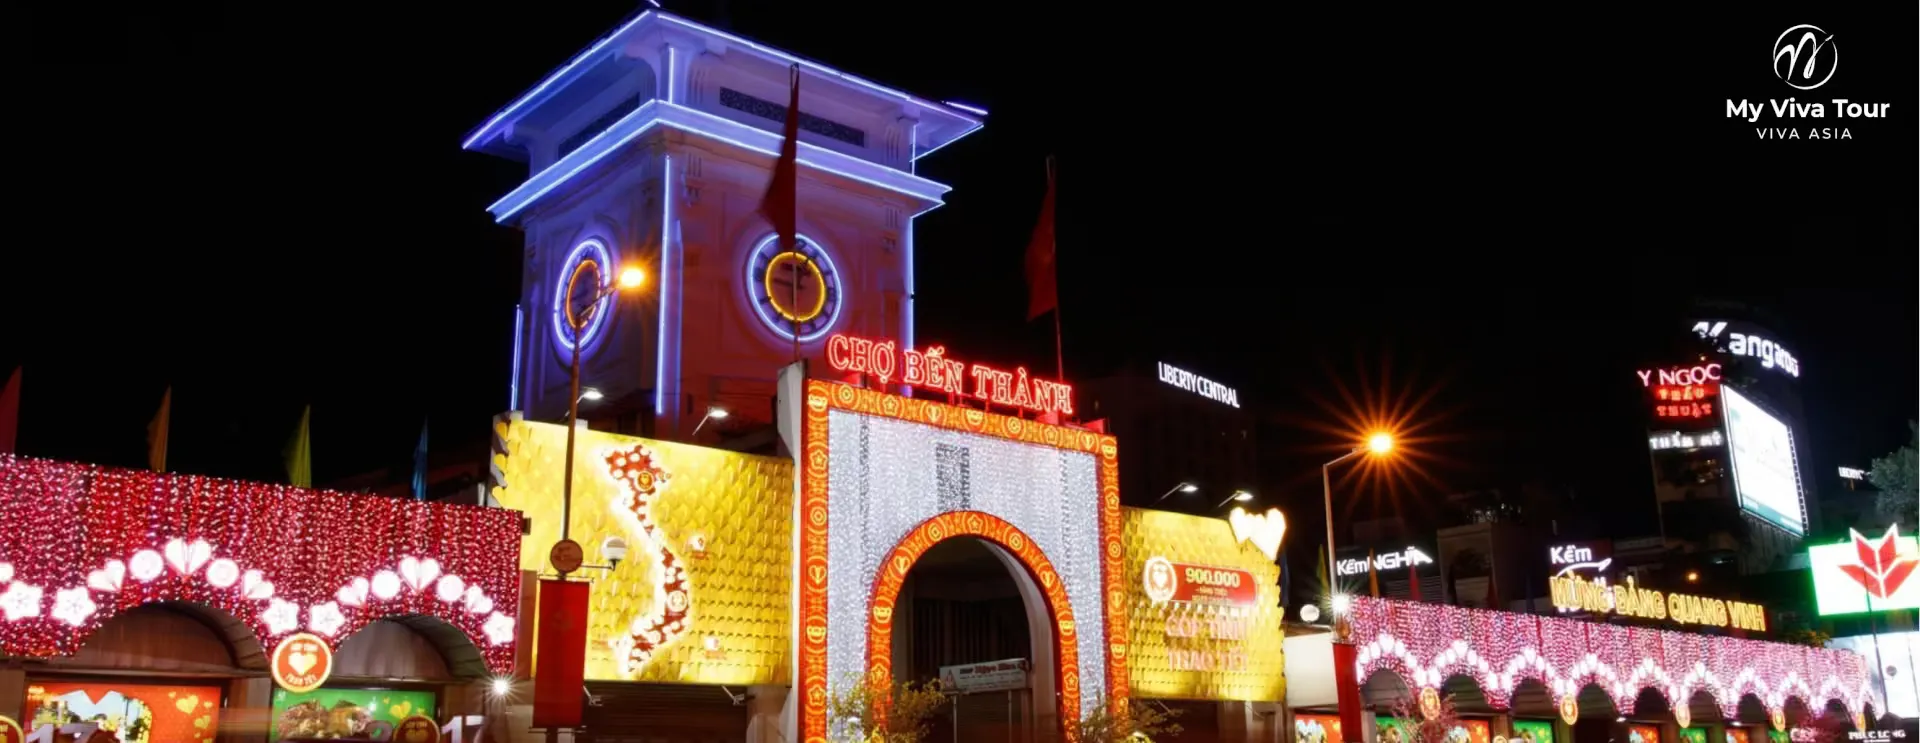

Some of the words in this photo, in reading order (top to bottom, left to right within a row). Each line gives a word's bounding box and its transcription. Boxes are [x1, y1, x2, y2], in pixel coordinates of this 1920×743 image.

[827, 333, 896, 384] CHỢ
[903, 345, 965, 395] BẾN
[971, 366, 1074, 415] THÀNH
[1158, 361, 1197, 393] LIBERTY
[1197, 375, 1241, 409] CENTRAL
[1658, 362, 1722, 386] NGỌC
[1550, 544, 1593, 565] Kềm
[1184, 567, 1241, 588] 900.000
[1668, 592, 1728, 627] QUANG
[1727, 600, 1767, 632] VINH
